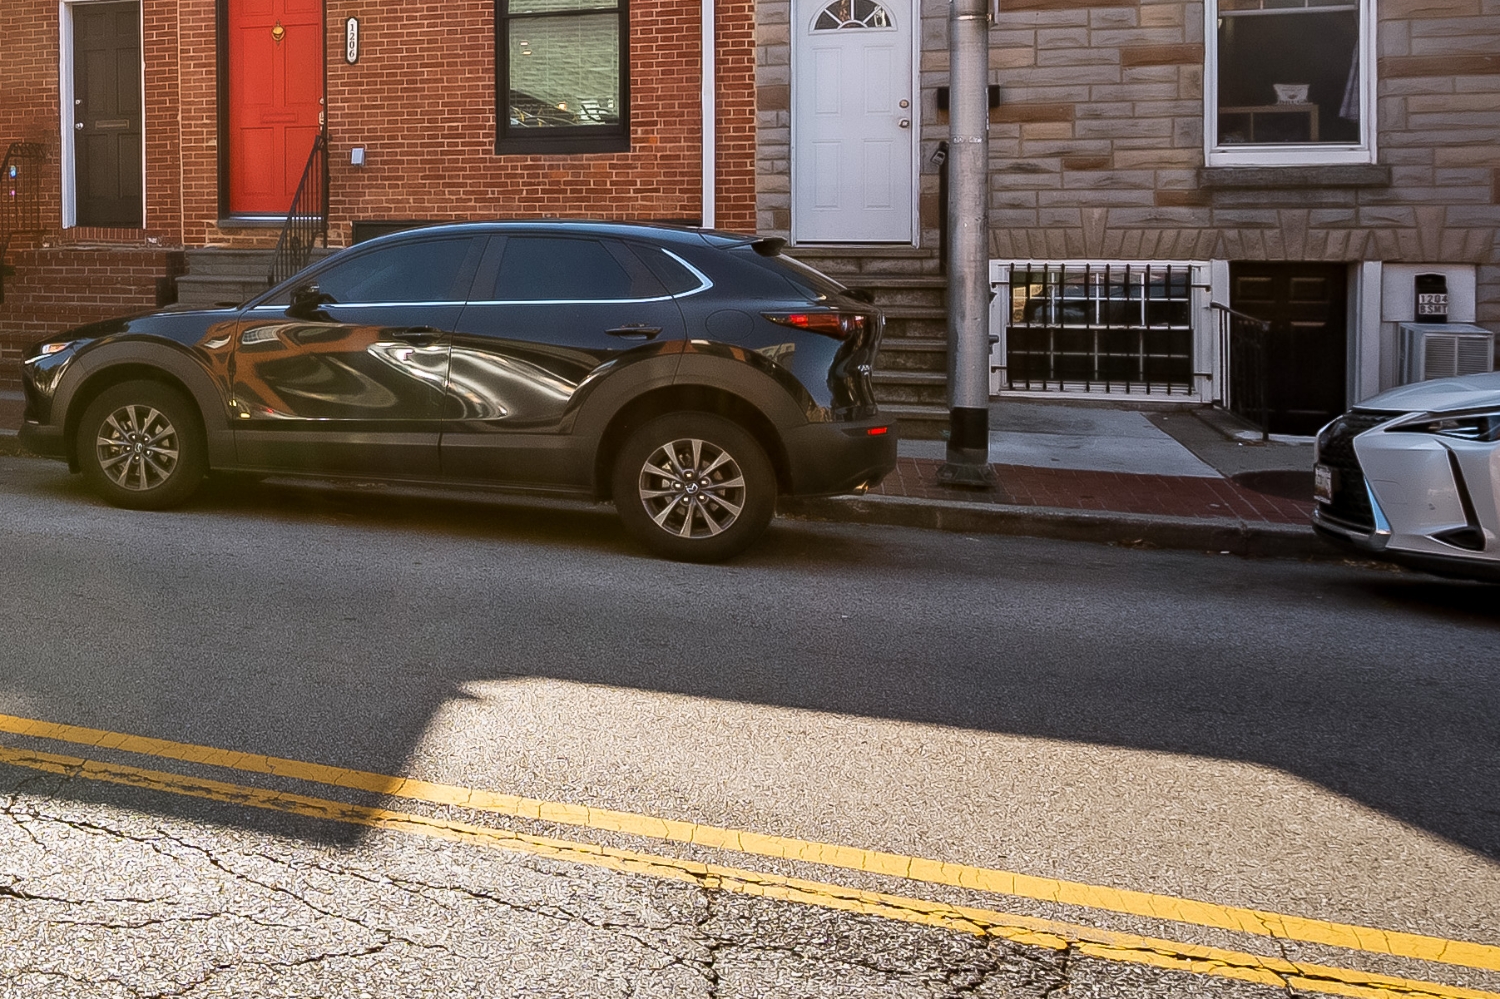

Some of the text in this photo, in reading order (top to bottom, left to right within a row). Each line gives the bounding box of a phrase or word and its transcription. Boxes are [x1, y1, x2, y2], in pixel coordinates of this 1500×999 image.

[348, 23, 356, 58] 1206
[1420, 294, 1448, 303] 1204
[1420, 305, 1447, 314] BSMT
